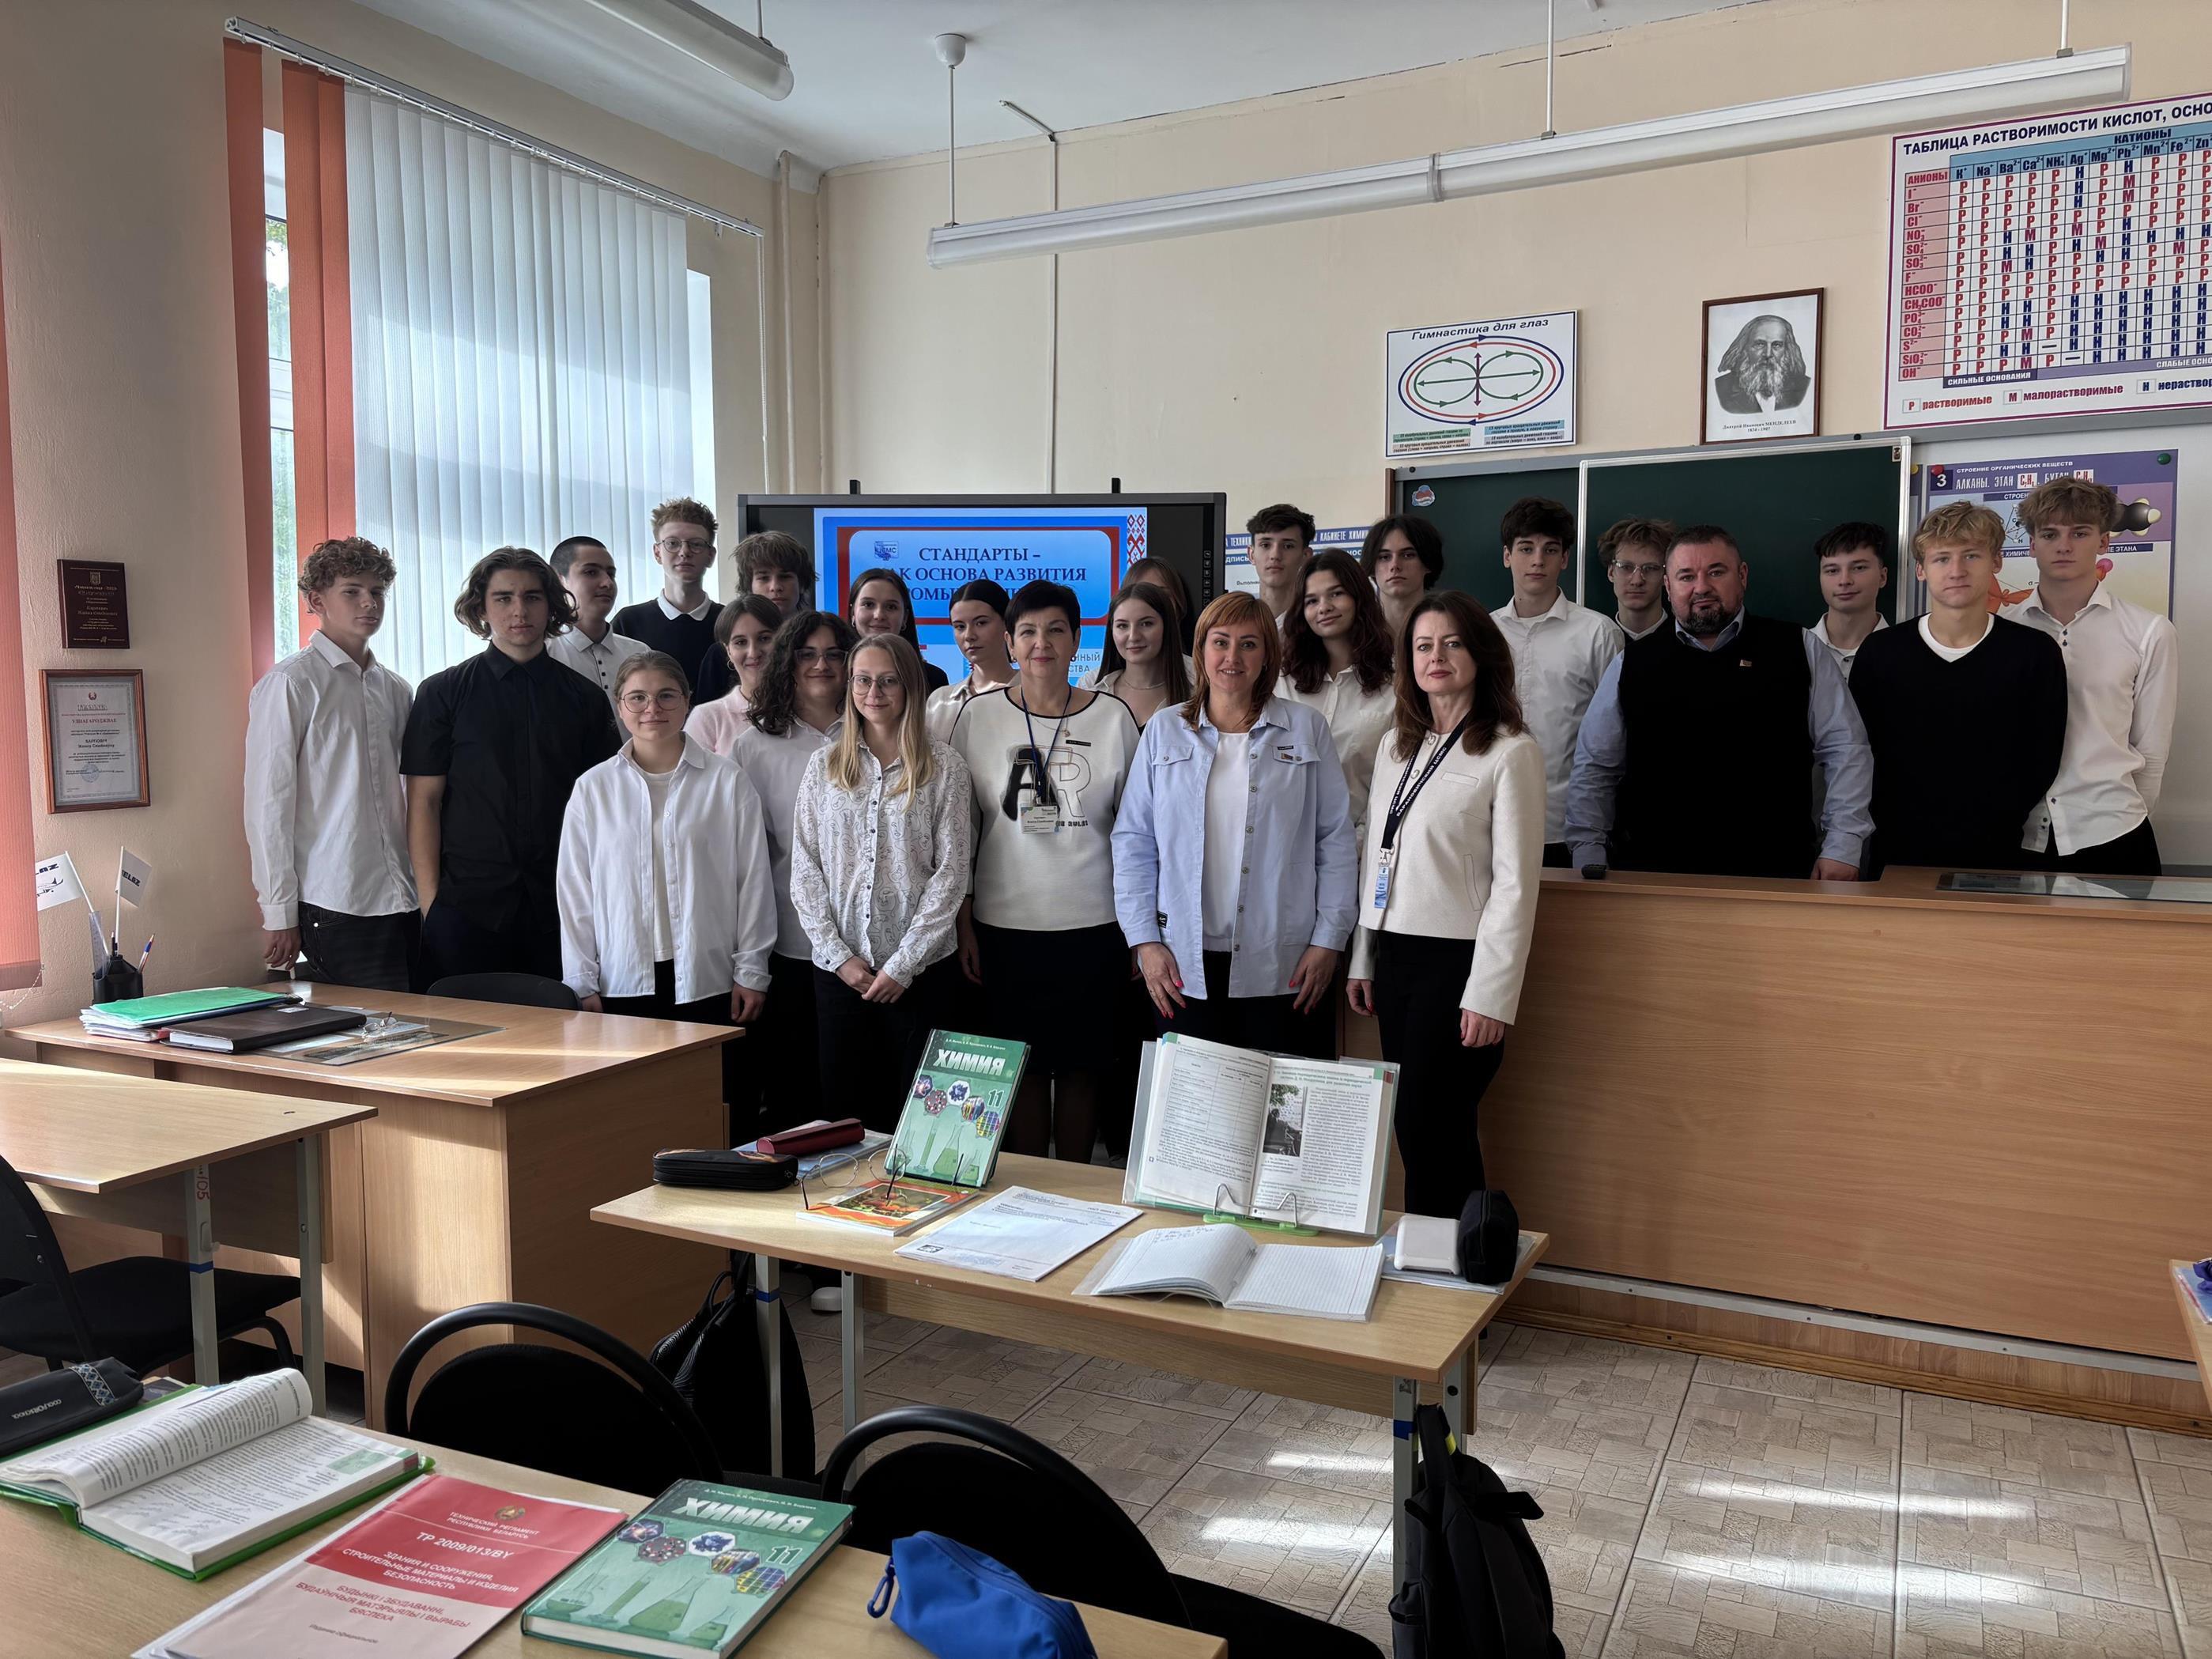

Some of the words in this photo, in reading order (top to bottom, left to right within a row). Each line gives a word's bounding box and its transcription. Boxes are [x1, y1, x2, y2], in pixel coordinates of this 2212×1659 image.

[1904, 136, 1969, 156] ТАБЛИЦА
[1972, 118, 2098, 145] РАСТВОРИМОСТИ
[2102, 109, 2167, 128] КИСЛОТ,
[2114, 128, 2172, 145] КАТИОНЫ
[1908, 171, 1948, 184] АНИОНЫ
[1959, 182, 1967, 193] Р
[1983, 179, 1991, 191] Р
[2005, 176, 2013, 187] Р
[2029, 172, 2036, 184] Р
[2052, 169, 2059, 182] Р
[2075, 166, 2084, 179] Н
[2099, 164, 2107, 176] Р
[2124, 161, 2133, 172] Н
[2151, 157, 2159, 169] Р
[2179, 153, 2187, 164] Р
[2203, 150, 2210, 163] Р
[1957, 253, 1965, 264] Р
[1980, 248, 1987, 259] Р
[2003, 248, 2012, 259] Н
[2025, 244, 2034, 255] Н
[2048, 241, 2056, 253] Р
[2073, 239, 2082, 250] Н
[2095, 236, 2106, 248] М
[2122, 233, 2131, 245] Н
[2147, 231, 2156, 242] Н
[2176, 226, 2184, 239] Н
[2200, 224, 2209, 236] Н
[1954, 307, 1962, 319] Р
[1978, 304, 1986, 316] Р
[2001, 303, 2010, 315] Н
[2023, 300, 2032, 313] Н
[2048, 297, 2055, 309] Р
[2070, 296, 2079, 307] Н
[2094, 294, 2103, 306] Н
[2119, 292, 2128, 304] Н
[2144, 289, 2152, 302] Н
[2172, 287, 2180, 299] Н
[2198, 285, 2206, 297] Н
[1411, 327, 1489, 340] Гимнастика
[1493, 323, 1516, 331] для
[1519, 319, 1550, 328] глаз
[2157, 358, 2190, 368] СЛАБЫЕ
[1947, 376, 1984, 386] СИЛЬНЫЕ
[1985, 372, 2031, 383] ОСНОВАНИЯ
[2142, 382, 2150, 391] Н
[1908, 401, 1915, 410] Р
[1922, 395, 1992, 410] растворимые
[2008, 392, 2018, 402] М
[2023, 384, 2123, 401] малорастворимые
[1936, 474, 1947, 487] 3
[1956, 478, 1991, 490] АЛКАНЫ.
[1994, 475, 2014, 487] ЭТАН
[1320, 531, 1346, 542] КАБИНЕТЕ
[919, 547, 1028, 563] СТАНДАРТЫ
[915, 568, 988, 580] ОСНОВА
[995, 568, 1086, 581] РАЗВИТИЯ
[1434, 746, 1447, 765] ЦСМС
[933, 1049, 1006, 1075] ХИМИЯ
[987, 1089, 1005, 1108] 11
[450, 1511, 498, 1527] ТЕХНИЧЕСКИЙ
[499, 1525, 540, 1535] РЕГЛАМЕНТ
[671, 1497, 814, 1533] ХИМИЯ
[447, 1517, 492, 1532] РЕСПУБЛИКИ
[493, 1529, 529, 1539] БЕЛАРУСЬ
[417, 1532, 436, 1544] ТР
[434, 1538, 514, 1559] 2009/013/BY
[765, 1544, 803, 1565] 11
[342, 1548, 412, 1572] СТРОИТЕЛЬНЫЕ
[412, 1568, 468, 1584] МАТЕРИАЛЫ
[474, 1580, 519, 1593] ИЗДЕЛИЯ
[383, 1551, 422, 1566] ЗДАНИЯ
[430, 1564, 494, 1581] СООРУЖЕНИЯ,
[383, 1570, 456, 1589] БЕЗОПАСНОСТЬ
[296, 1582, 357, 1604] БУДАЎНІЧЫЯ
[357, 1600, 419, 1618] МАТЭРЫЯЛЫ
[425, 1616, 470, 1627] ВЫРАБЫ
[337, 1585, 379, 1604] БУДЫНКІ
[383, 1597, 444, 1614] ЗБУДАВАННІ,
[349, 1608, 394, 1622] БЯСПЕКА
